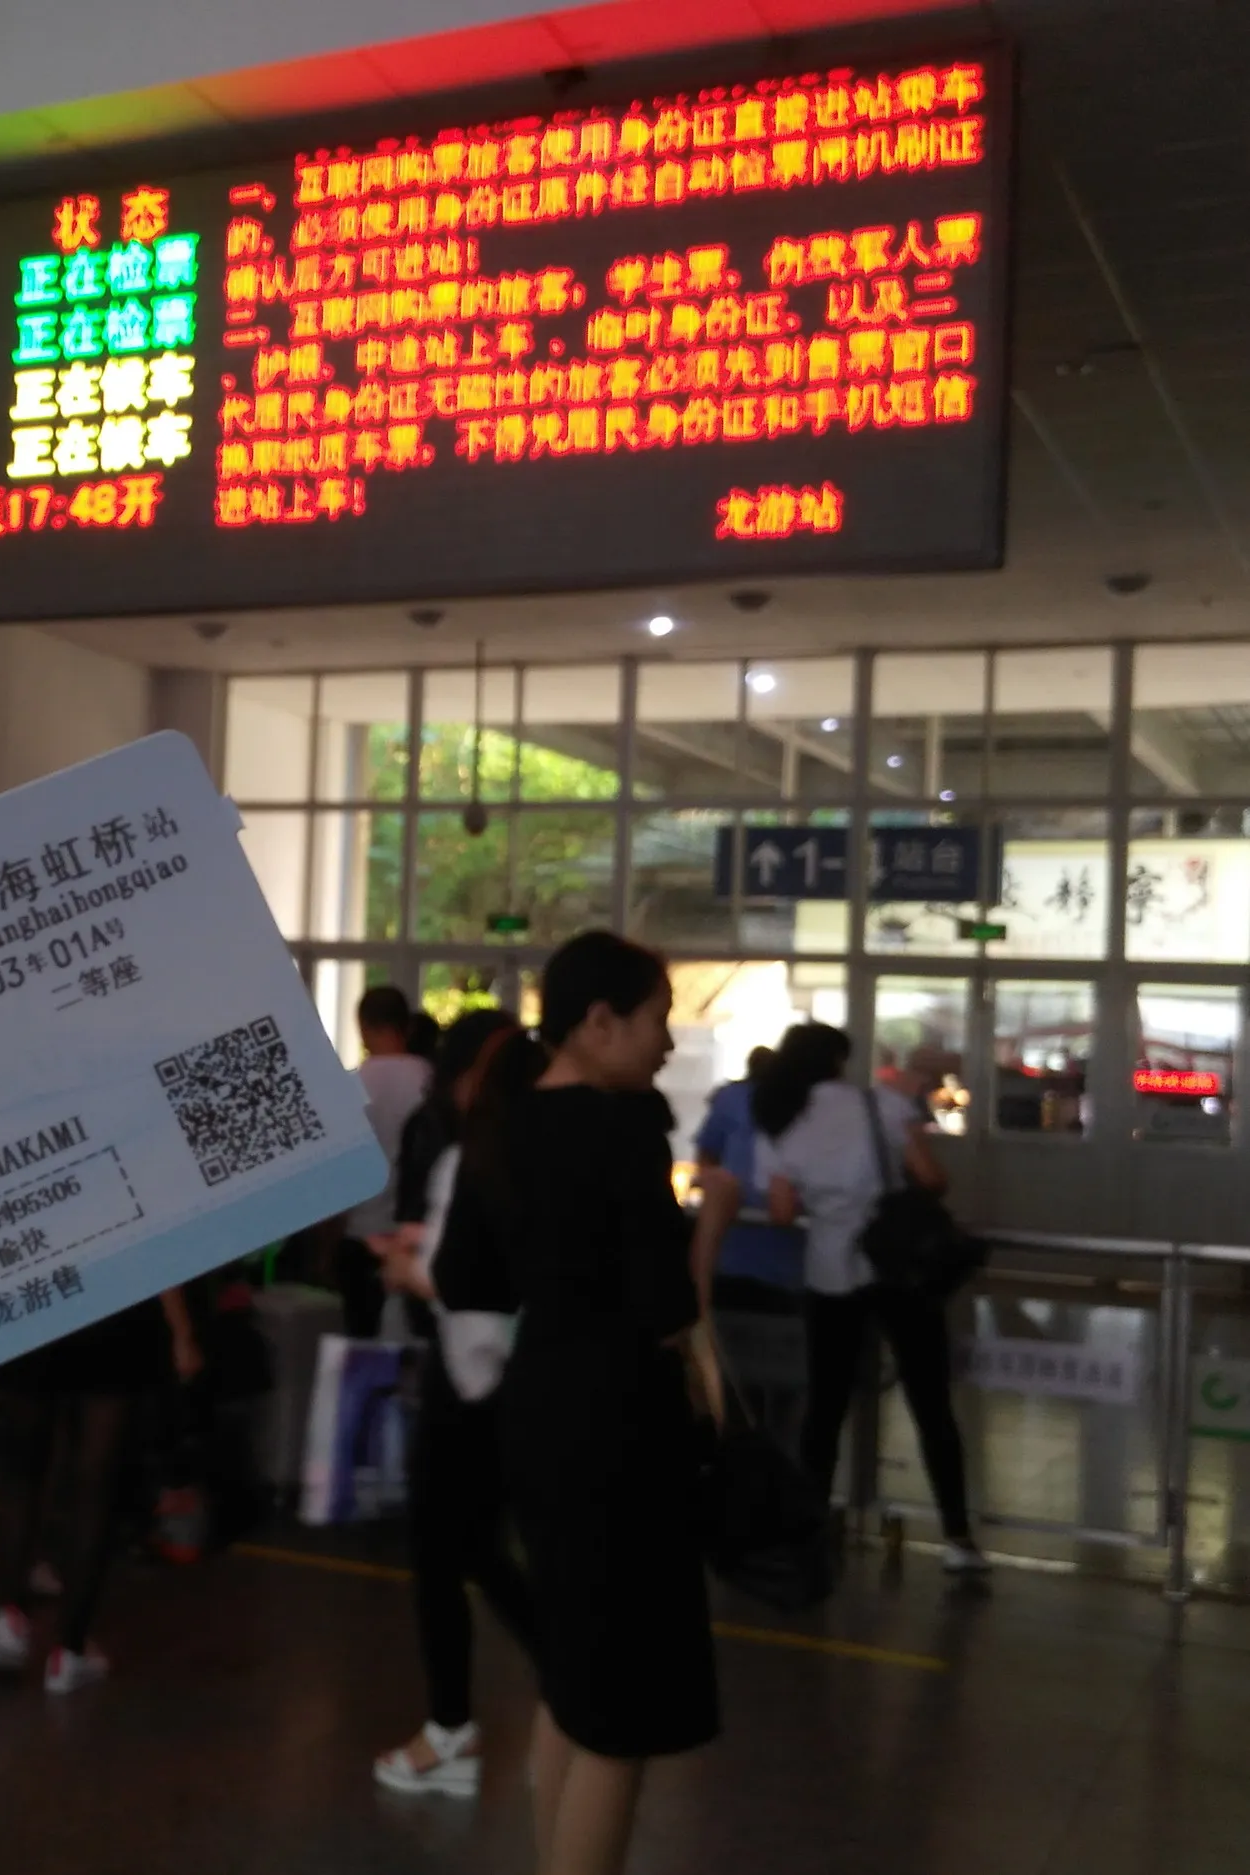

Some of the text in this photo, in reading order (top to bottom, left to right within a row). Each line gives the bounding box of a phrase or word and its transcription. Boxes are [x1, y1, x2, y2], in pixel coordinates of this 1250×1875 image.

[53, 188, 170, 251] 状态
[15, 232, 200, 308] 正在检票
[12, 291, 197, 366] 正在检票
[10, 350, 195, 421] 正在候车
[7, 409, 194, 479] 正在候车
[715, 480, 844, 540] 龙游站
[50, 954, 143, 1011] 二等座
